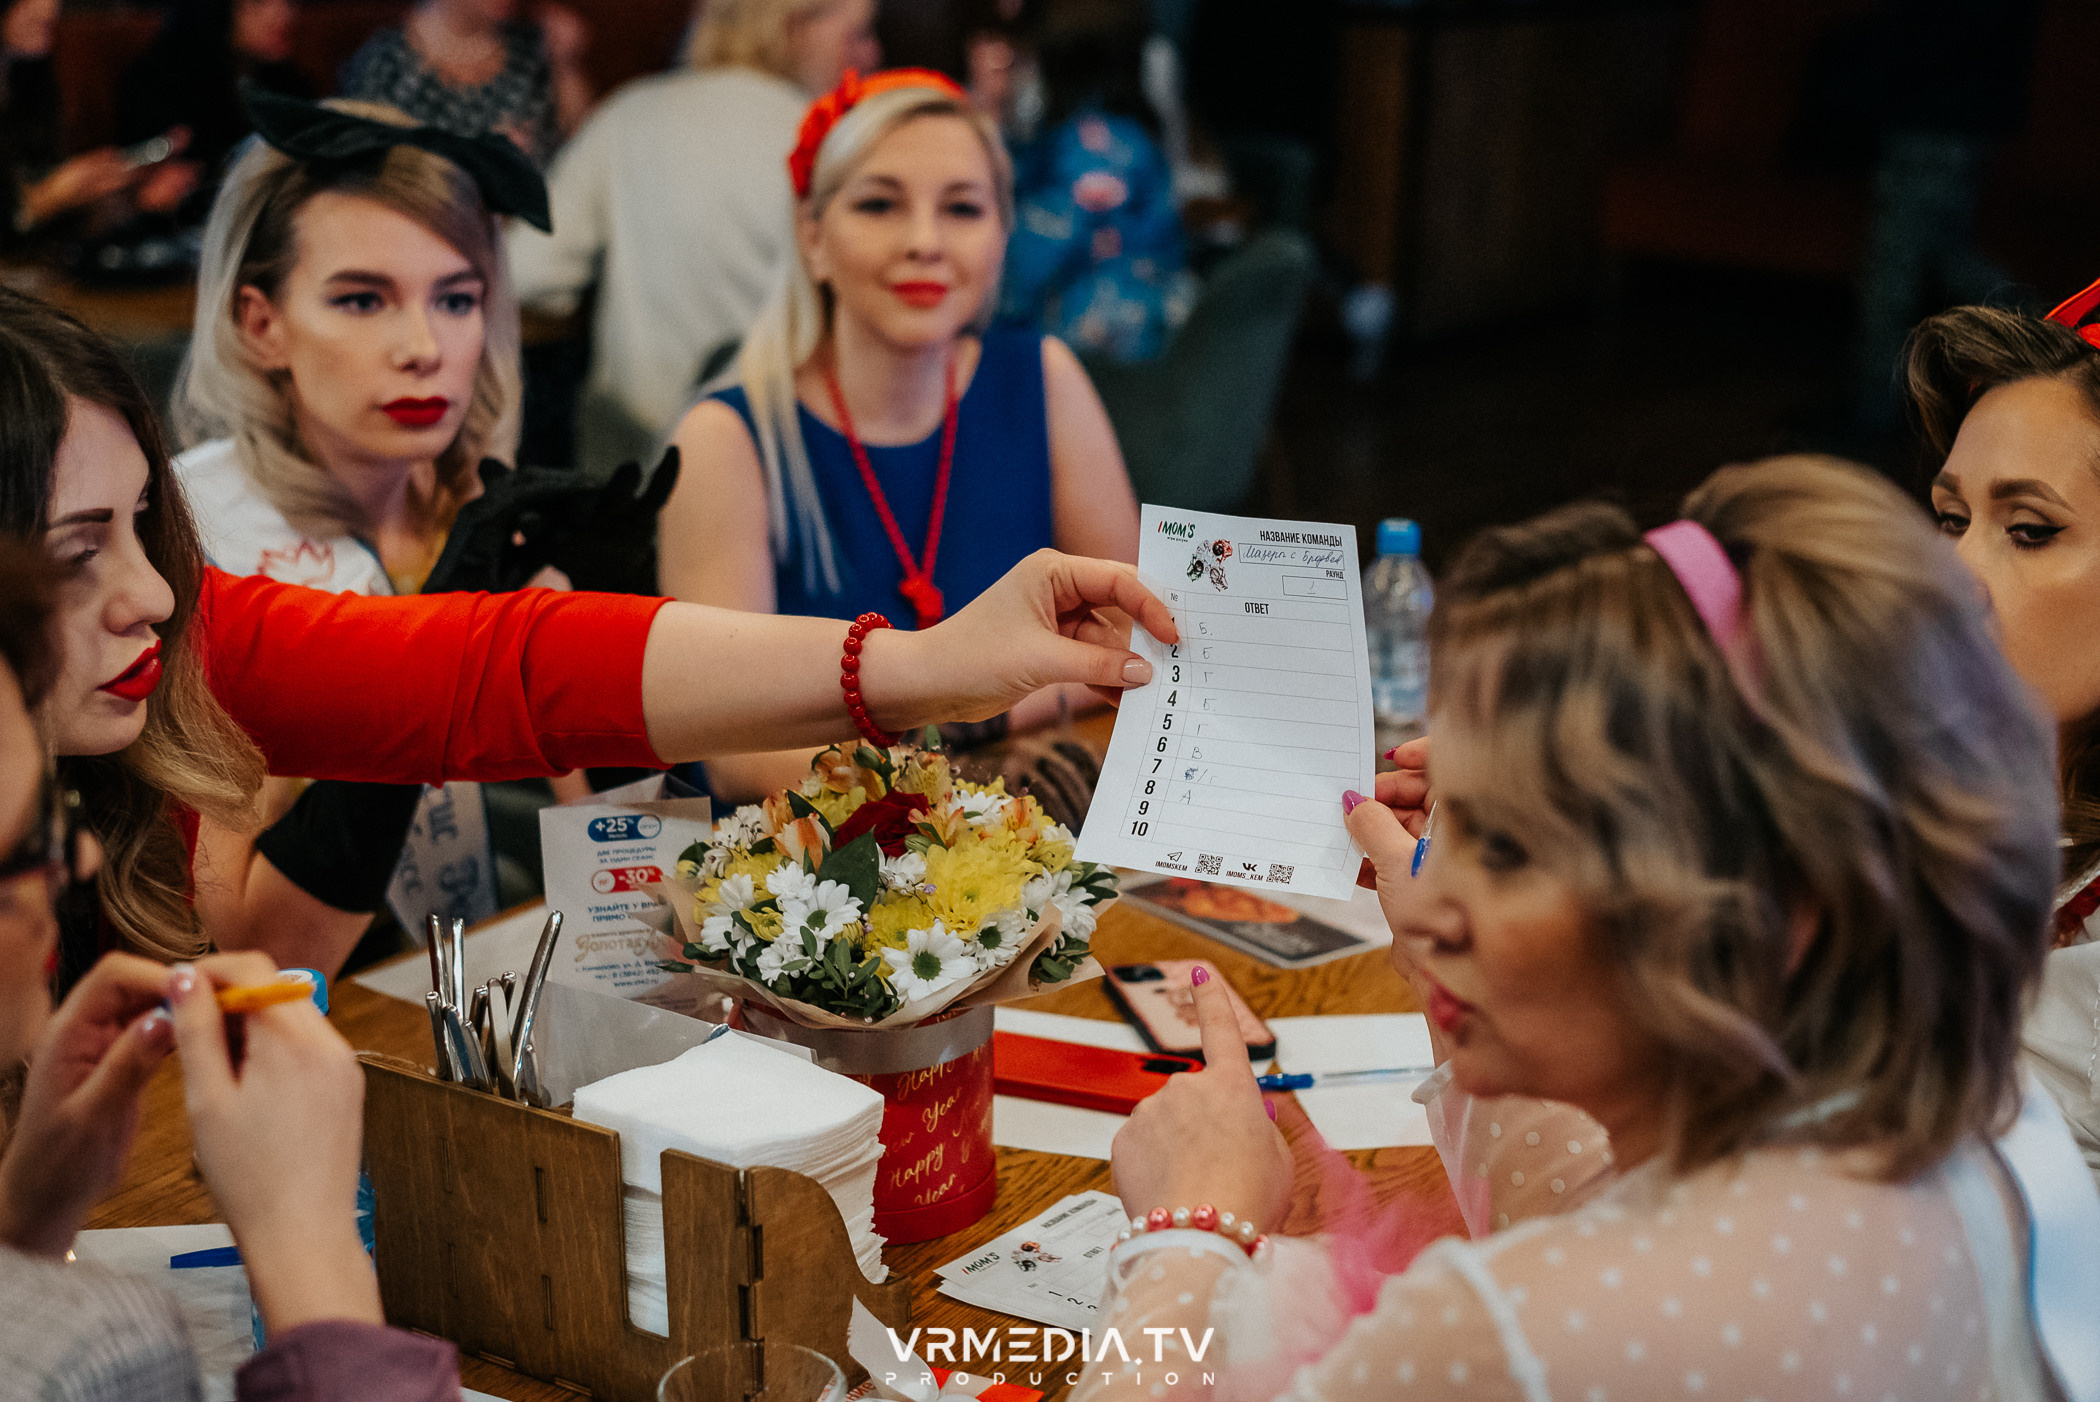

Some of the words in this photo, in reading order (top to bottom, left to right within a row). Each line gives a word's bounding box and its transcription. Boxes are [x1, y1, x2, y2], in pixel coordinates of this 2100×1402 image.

[1259, 530, 1301, 544] НАЗВАНИЕ
[1301, 533, 1343, 547] КОМАНДЫ
[1325, 570, 1345, 579] РАУНД
[1244, 602, 1270, 615] ОТВЕТ
[1170, 644, 1179, 658] 2
[1172, 665, 1180, 682] 3
[1167, 690, 1177, 707] 4
[1162, 713, 1173, 730] 5
[1157, 737, 1168, 752] 6
[1151, 758, 1162, 774] 7
[1144, 780, 1156, 795] 8
[1138, 800, 1149, 815] 9
[1131, 821, 1149, 837] 10
[1155, 861, 1188, 872] IMOMSKEM
[1225, 870, 1264, 882] IMOMS_KEM
[588, 903, 629, 914] УЗНАЙТЕ
[1067, 1297, 1084, 1306] 2
